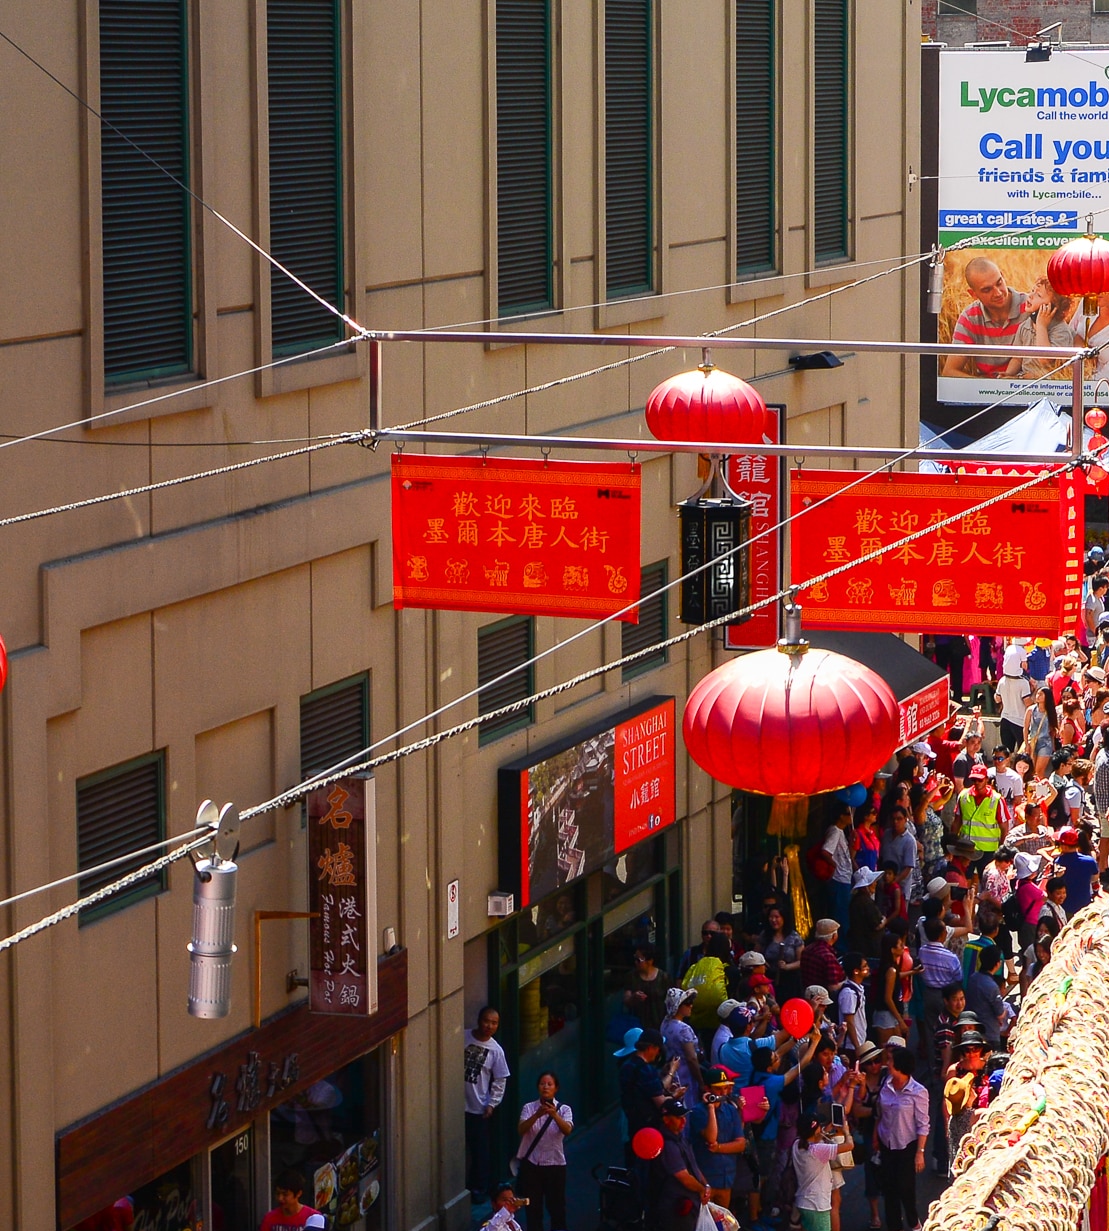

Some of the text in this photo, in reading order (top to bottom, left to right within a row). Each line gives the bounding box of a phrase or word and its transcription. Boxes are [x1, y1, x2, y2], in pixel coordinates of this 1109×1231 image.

[1037, 111, 1057, 121] Call
[1059, 111, 1078, 121] the
[1078, 111, 1108, 121] world
[979, 133, 1043, 160] Call
[978, 167, 1045, 184] friends
[1051, 168, 1065, 184] &
[1007, 190, 1029, 199] with
[945, 213, 1070, 226] great call rates &
[451, 492, 579, 522] 歡迎來臨
[855, 508, 992, 536] 歡迎來臨
[422, 519, 610, 553] 墨爾本唐人街
[822, 535, 1027, 570] 墨爾本唐人街
[756, 522, 769, 618] SHANGHI
[623, 711, 667, 748] SHANGHAI
[623, 732, 667, 775] STREET
[318, 784, 357, 887] 名爐
[321, 894, 334, 944] Famous
[322, 949, 335, 976] Hot
[338, 896, 362, 1007] 港式火鍋
[235, 1134, 249, 1156] 150
